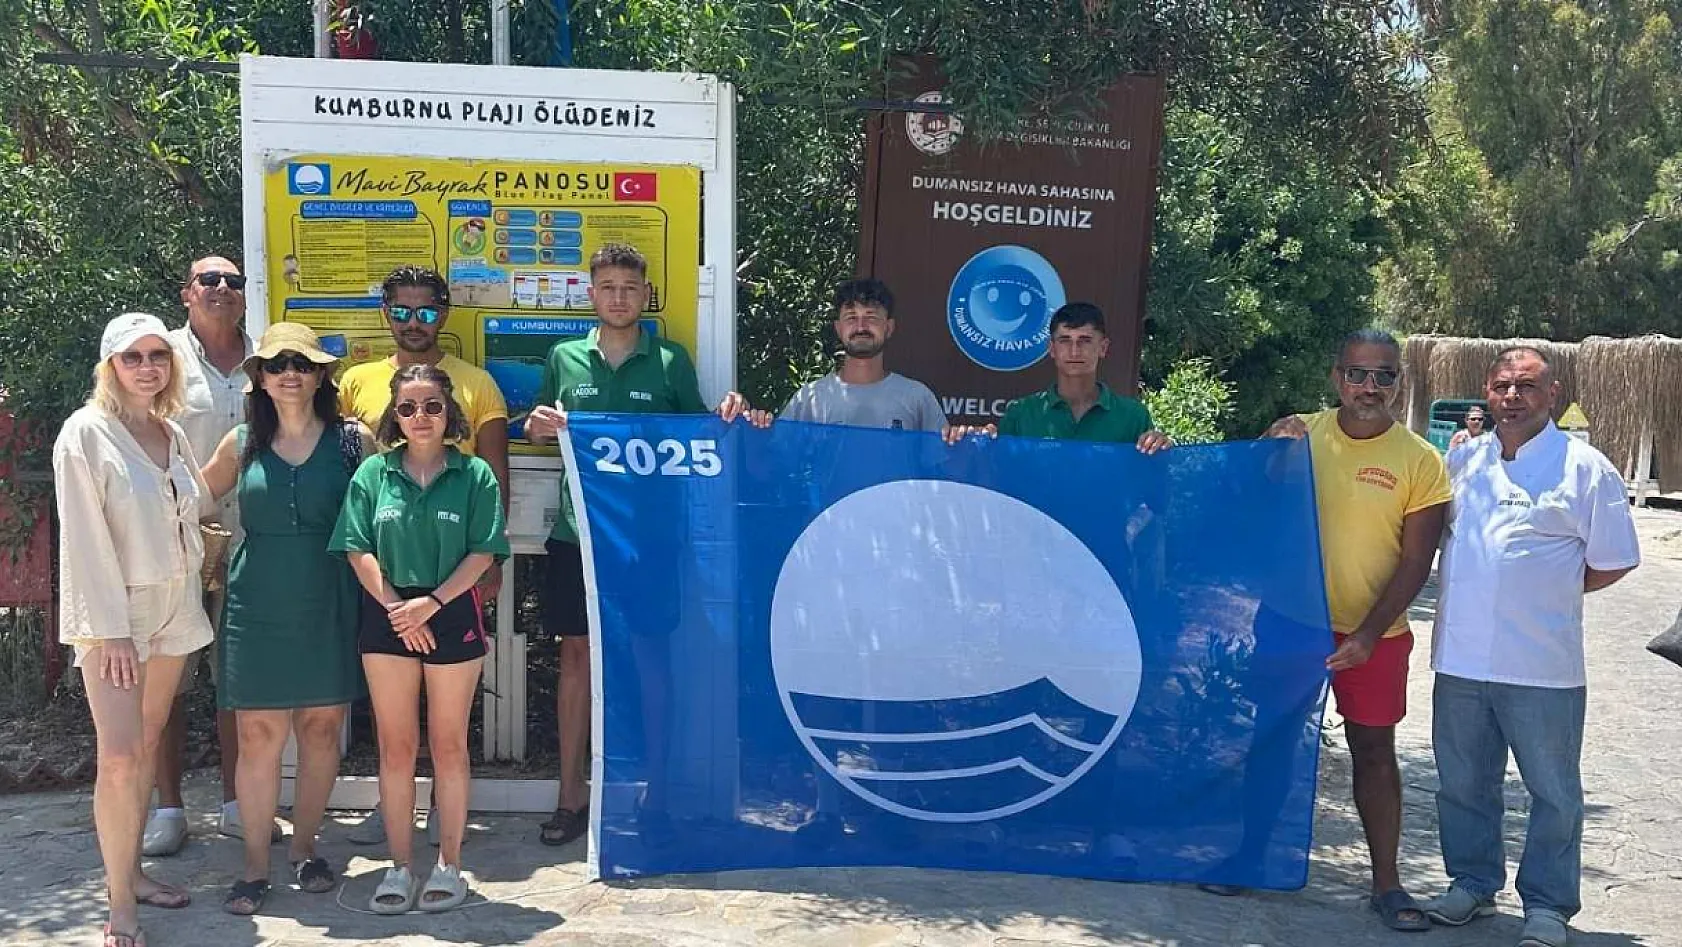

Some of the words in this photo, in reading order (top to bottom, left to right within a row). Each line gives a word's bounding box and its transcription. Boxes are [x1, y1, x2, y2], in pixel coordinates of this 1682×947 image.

[314, 95, 452, 120] KUMBURNU
[462, 101, 523, 125] PLAJI
[534, 100, 656, 128] ÖLÜDENİZ
[336, 168, 402, 195] Mavi
[401, 170, 488, 203] Bayrak
[495, 171, 609, 190] PANOSU
[912, 176, 994, 193] DUMANSIZ
[996, 181, 1037, 197] HAVA
[1040, 184, 1115, 201] SAHASINA
[933, 200, 1092, 229] HOŞGELDİNİZ
[512, 321, 577, 331] KUMBURNU
[995, 338, 1034, 351] HAVA
[591, 437, 722, 477] 2025
